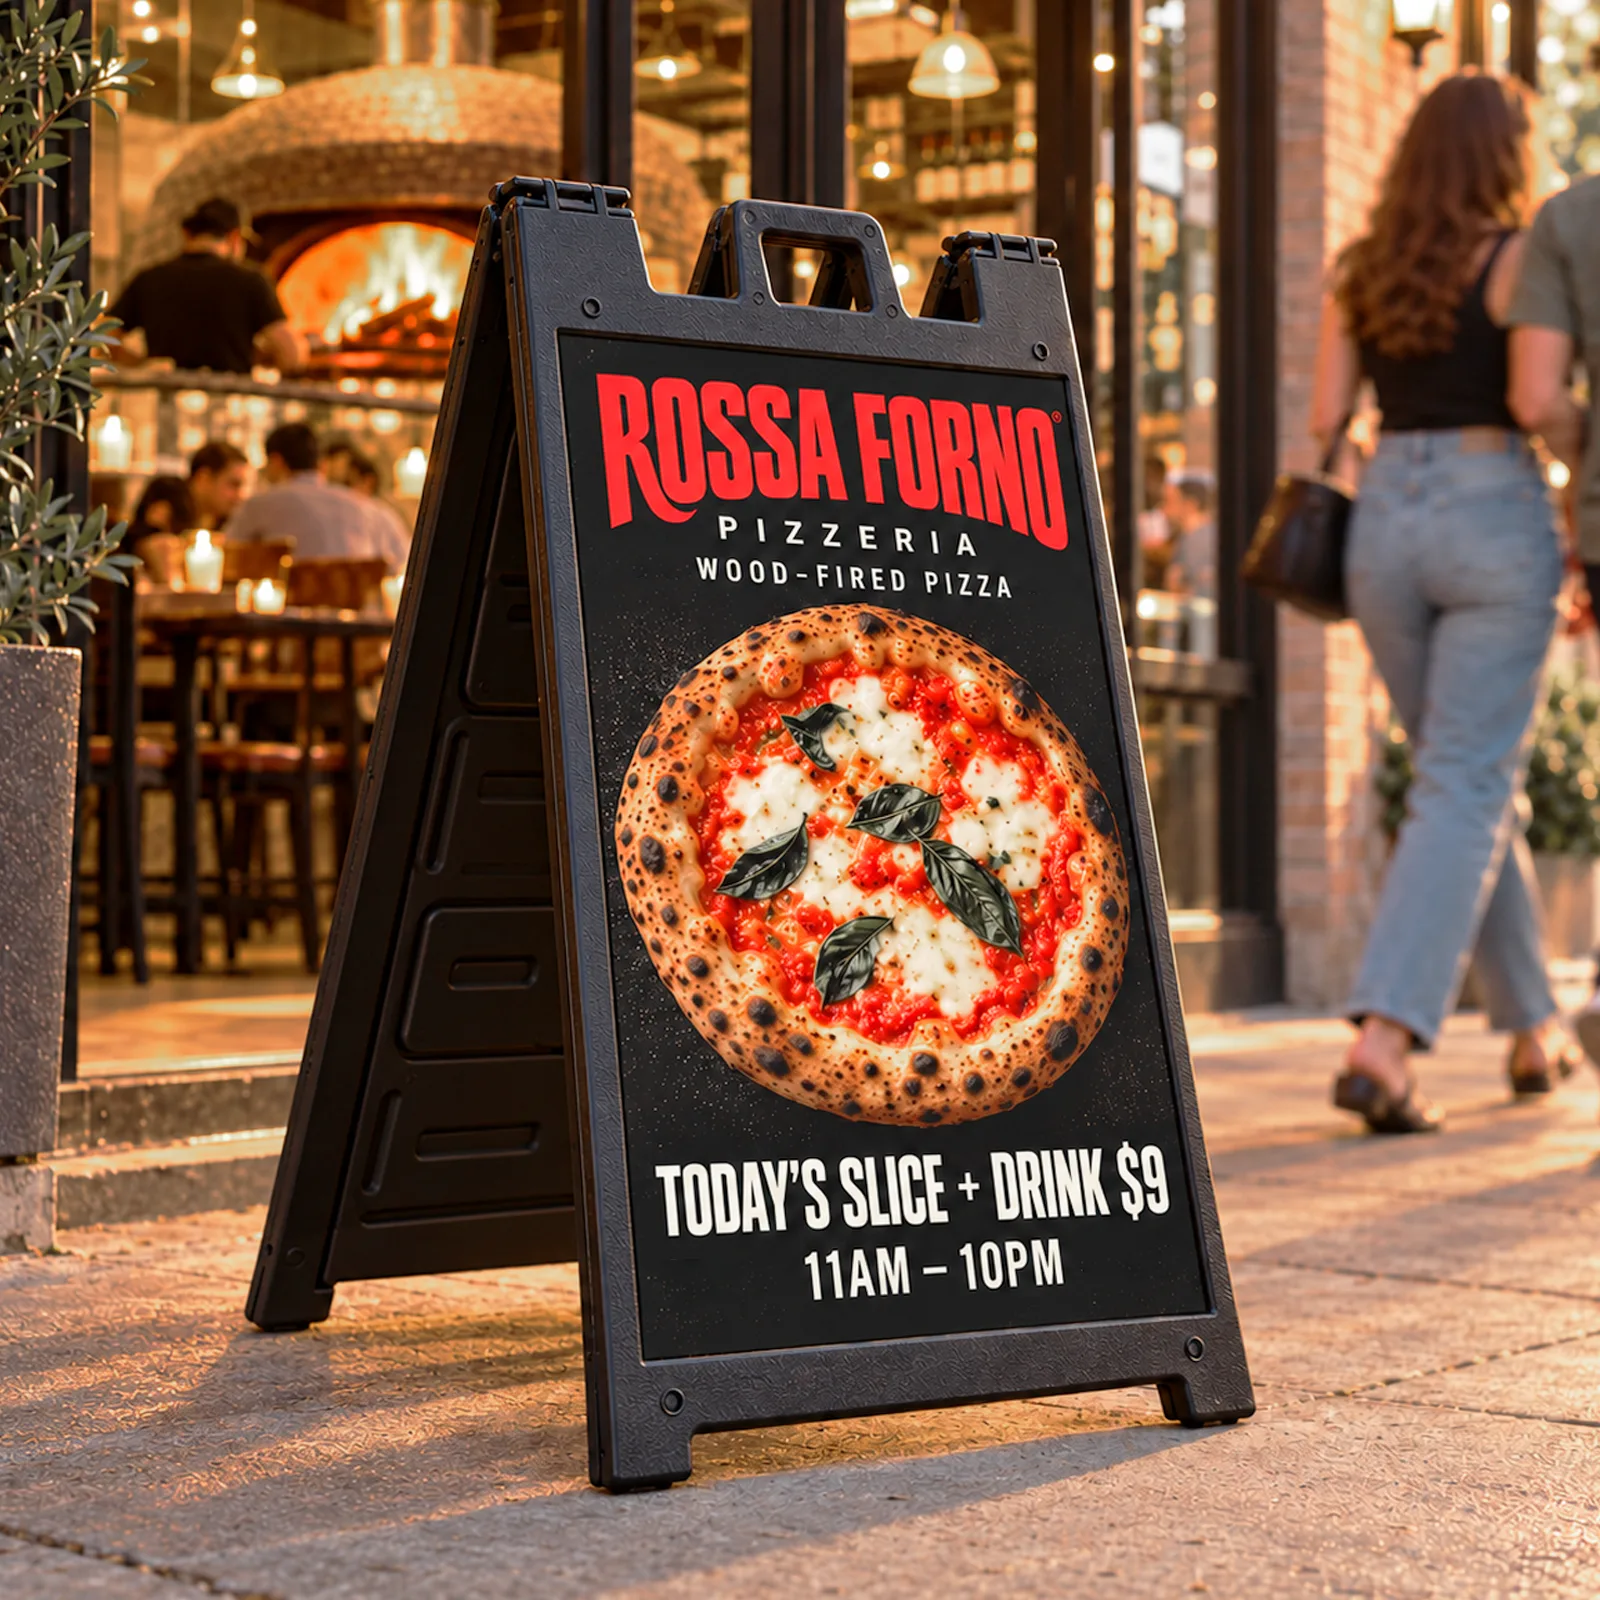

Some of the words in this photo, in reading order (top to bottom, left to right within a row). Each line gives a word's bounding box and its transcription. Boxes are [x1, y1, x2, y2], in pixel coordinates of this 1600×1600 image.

[596, 373, 849, 529] ROSSA
[718, 515, 976, 557] PIZZERIA
[695, 556, 905, 592] WOOD-FIRED
[924, 571, 1012, 599] PIZZA
[655, 1158, 831, 1237] TODAY'S
[839, 1154, 949, 1228] SLICE
[957, 1172, 980, 1201] +
[990, 1148, 1111, 1221] DRINK
[1116, 1140, 1170, 1221] $9
[804, 1246, 911, 1301] 11AM
[959, 1238, 1064, 1290] 10PM
